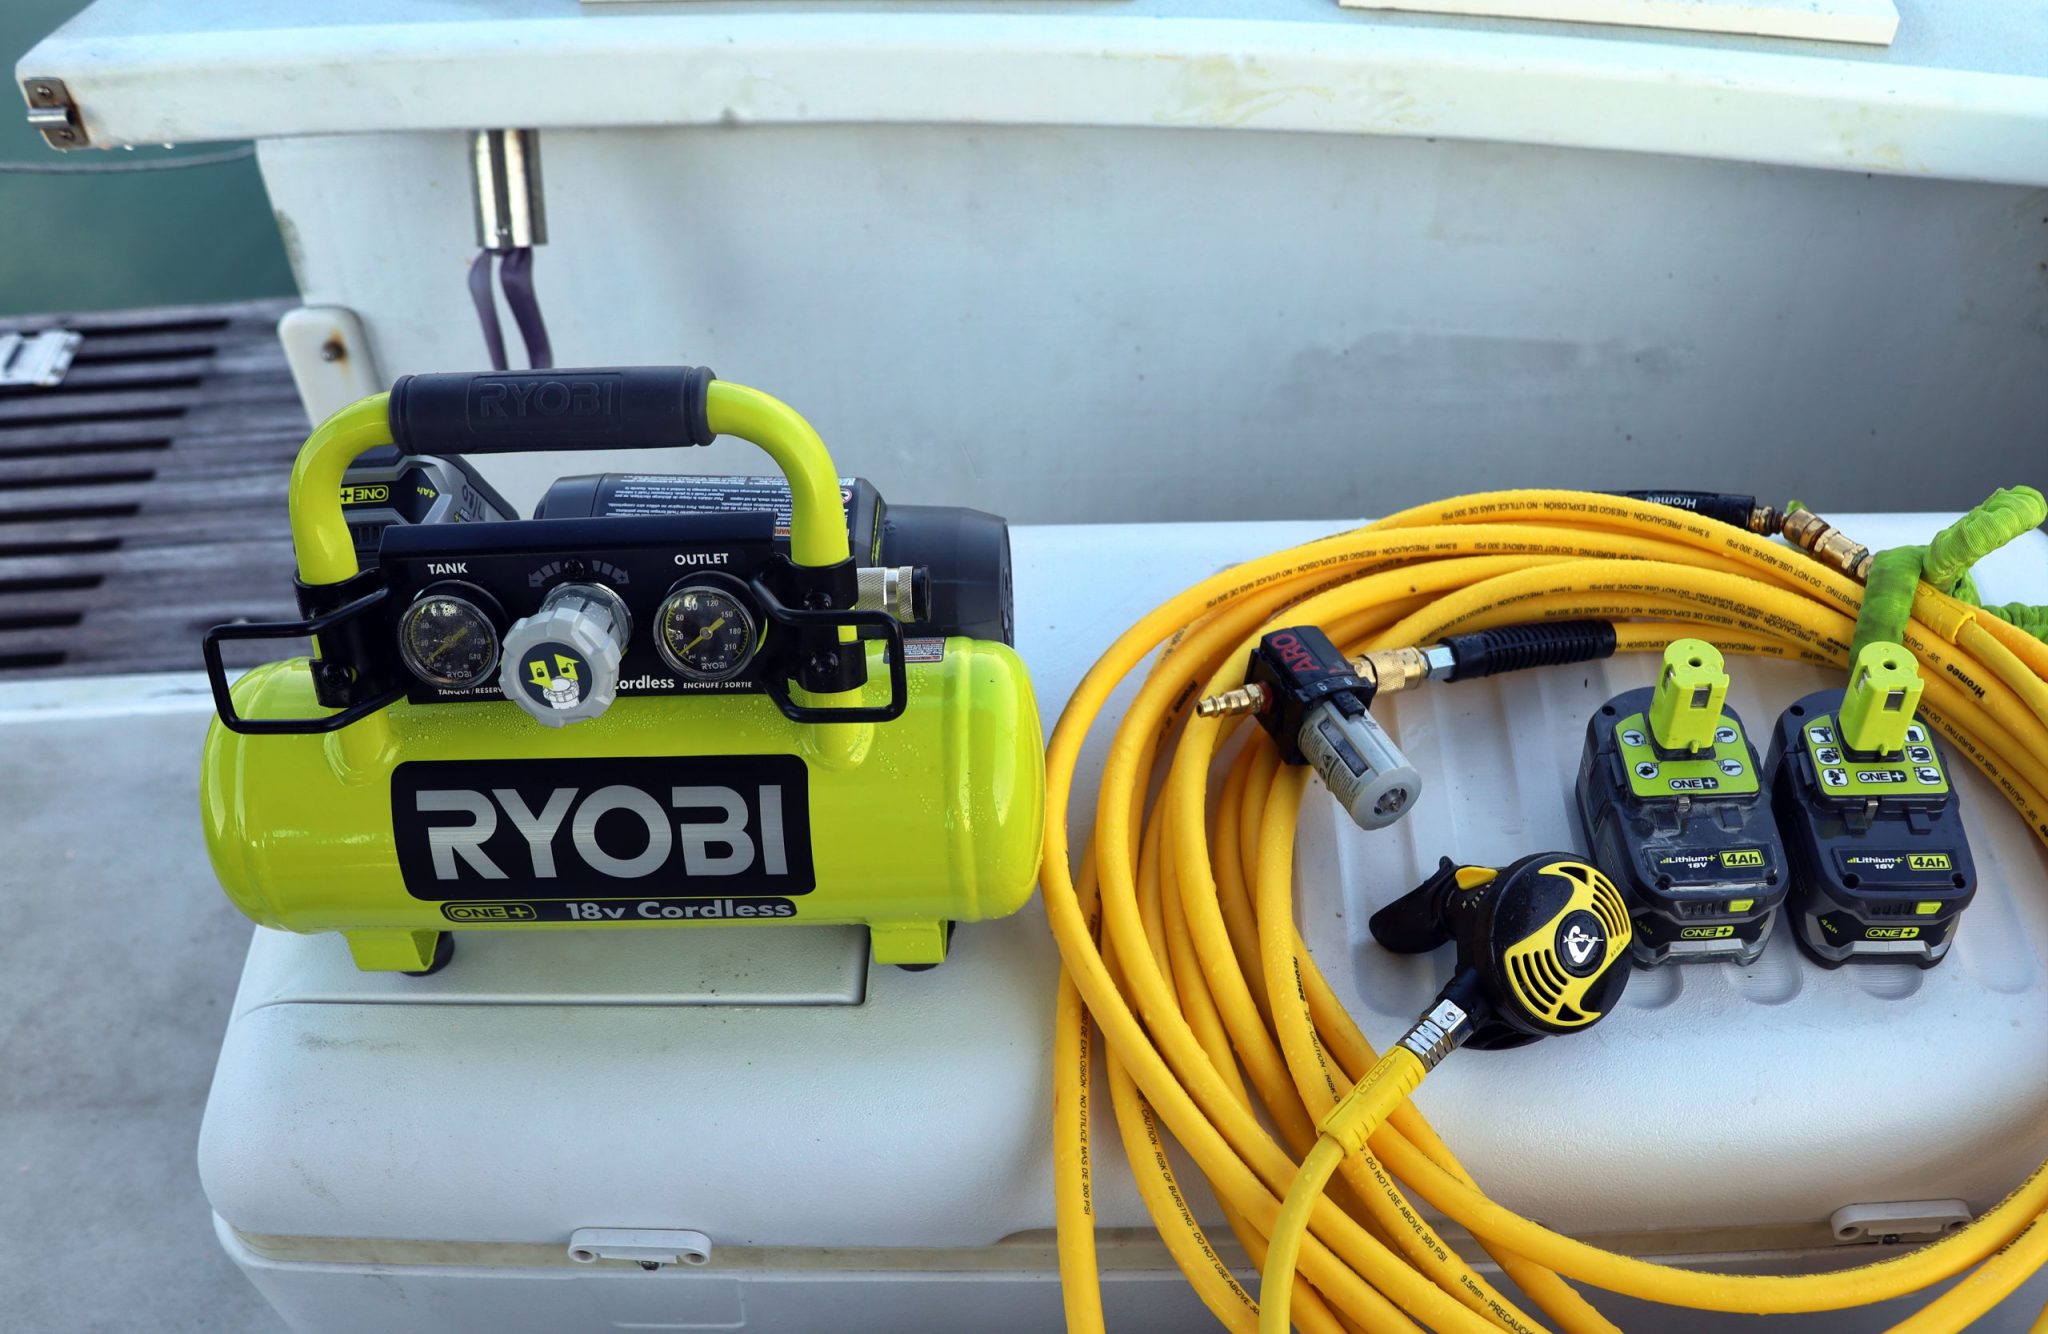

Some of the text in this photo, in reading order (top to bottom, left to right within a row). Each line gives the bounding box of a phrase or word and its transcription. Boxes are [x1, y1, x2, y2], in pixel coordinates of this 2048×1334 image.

[478, 381, 614, 418] RYOBI
[1468, 506, 1479, 515] DE
[1500, 502, 1526, 511] UTILICE
[1526, 501, 1538, 510] NO
[1587, 504, 1598, 513] DE
[1441, 511, 1454, 521] PSI
[1454, 508, 1467, 518] 300
[1599, 505, 1628, 517] RIESGO
[1474, 542, 1487, 550] PSI
[1487, 542, 1500, 550] 300
[1502, 542, 1527, 551] ABOVE
[1528, 544, 1543, 552] USE
[1726, 538, 1739, 548] PSI
[1545, 545, 1561, 553] NOT
[1561, 546, 1573, 554] DO
[1739, 544, 1751, 554] 300
[674, 552, 729, 566] OUTLET
[1753, 552, 1778, 566] ABOVE
[427, 562, 469, 575] TANK
[1282, 568, 1293, 578] NO
[706, 599, 719, 607] 120
[675, 614, 685, 622] 60
[721, 610, 734, 618] 150
[729, 627, 742, 635] 180
[724, 643, 737, 651] 210
[1271, 633, 1320, 673] ARO
[700, 661, 728, 670] RYOBI
[1946, 663, 1986, 700] Hromee
[1930, 711, 1941, 724] DO
[1858, 771, 1905, 782] ONE+
[1671, 778, 1717, 790] ONE+
[415, 784, 789, 880] RYOBI
[1726, 851, 1758, 865] 4Ah
[1913, 856, 1946, 868] 4Ah
[1687, 861, 1708, 869] 18V
[451, 900, 792, 920] ONE+ 18v Cordless
[1820, 918, 1838, 934] 4Ah
[1683, 927, 1732, 937] ONE+
[1868, 927, 1918, 937] ONE+
[1309, 1029, 1326, 1073] CAUTION
[1080, 1094, 1087, 1109] NO
[1141, 1108, 1158, 1145] CAUTION
[1154, 1151, 1167, 1171] RISK
[1162, 1172, 1173, 1185] OF
[1168, 1185, 1194, 1228] BURSTING
[1193, 1232, 1204, 1245] DO
[1201, 1245, 1217, 1263] NOT
[1214, 1262, 1230, 1281] USE
[1226, 1279, 1251, 1306] ABOVE
[1365, 1155, 1448, 1263] DO NOT USE ABOVE 300 PSI
[1460, 1274, 1485, 1300] 9.5mm
